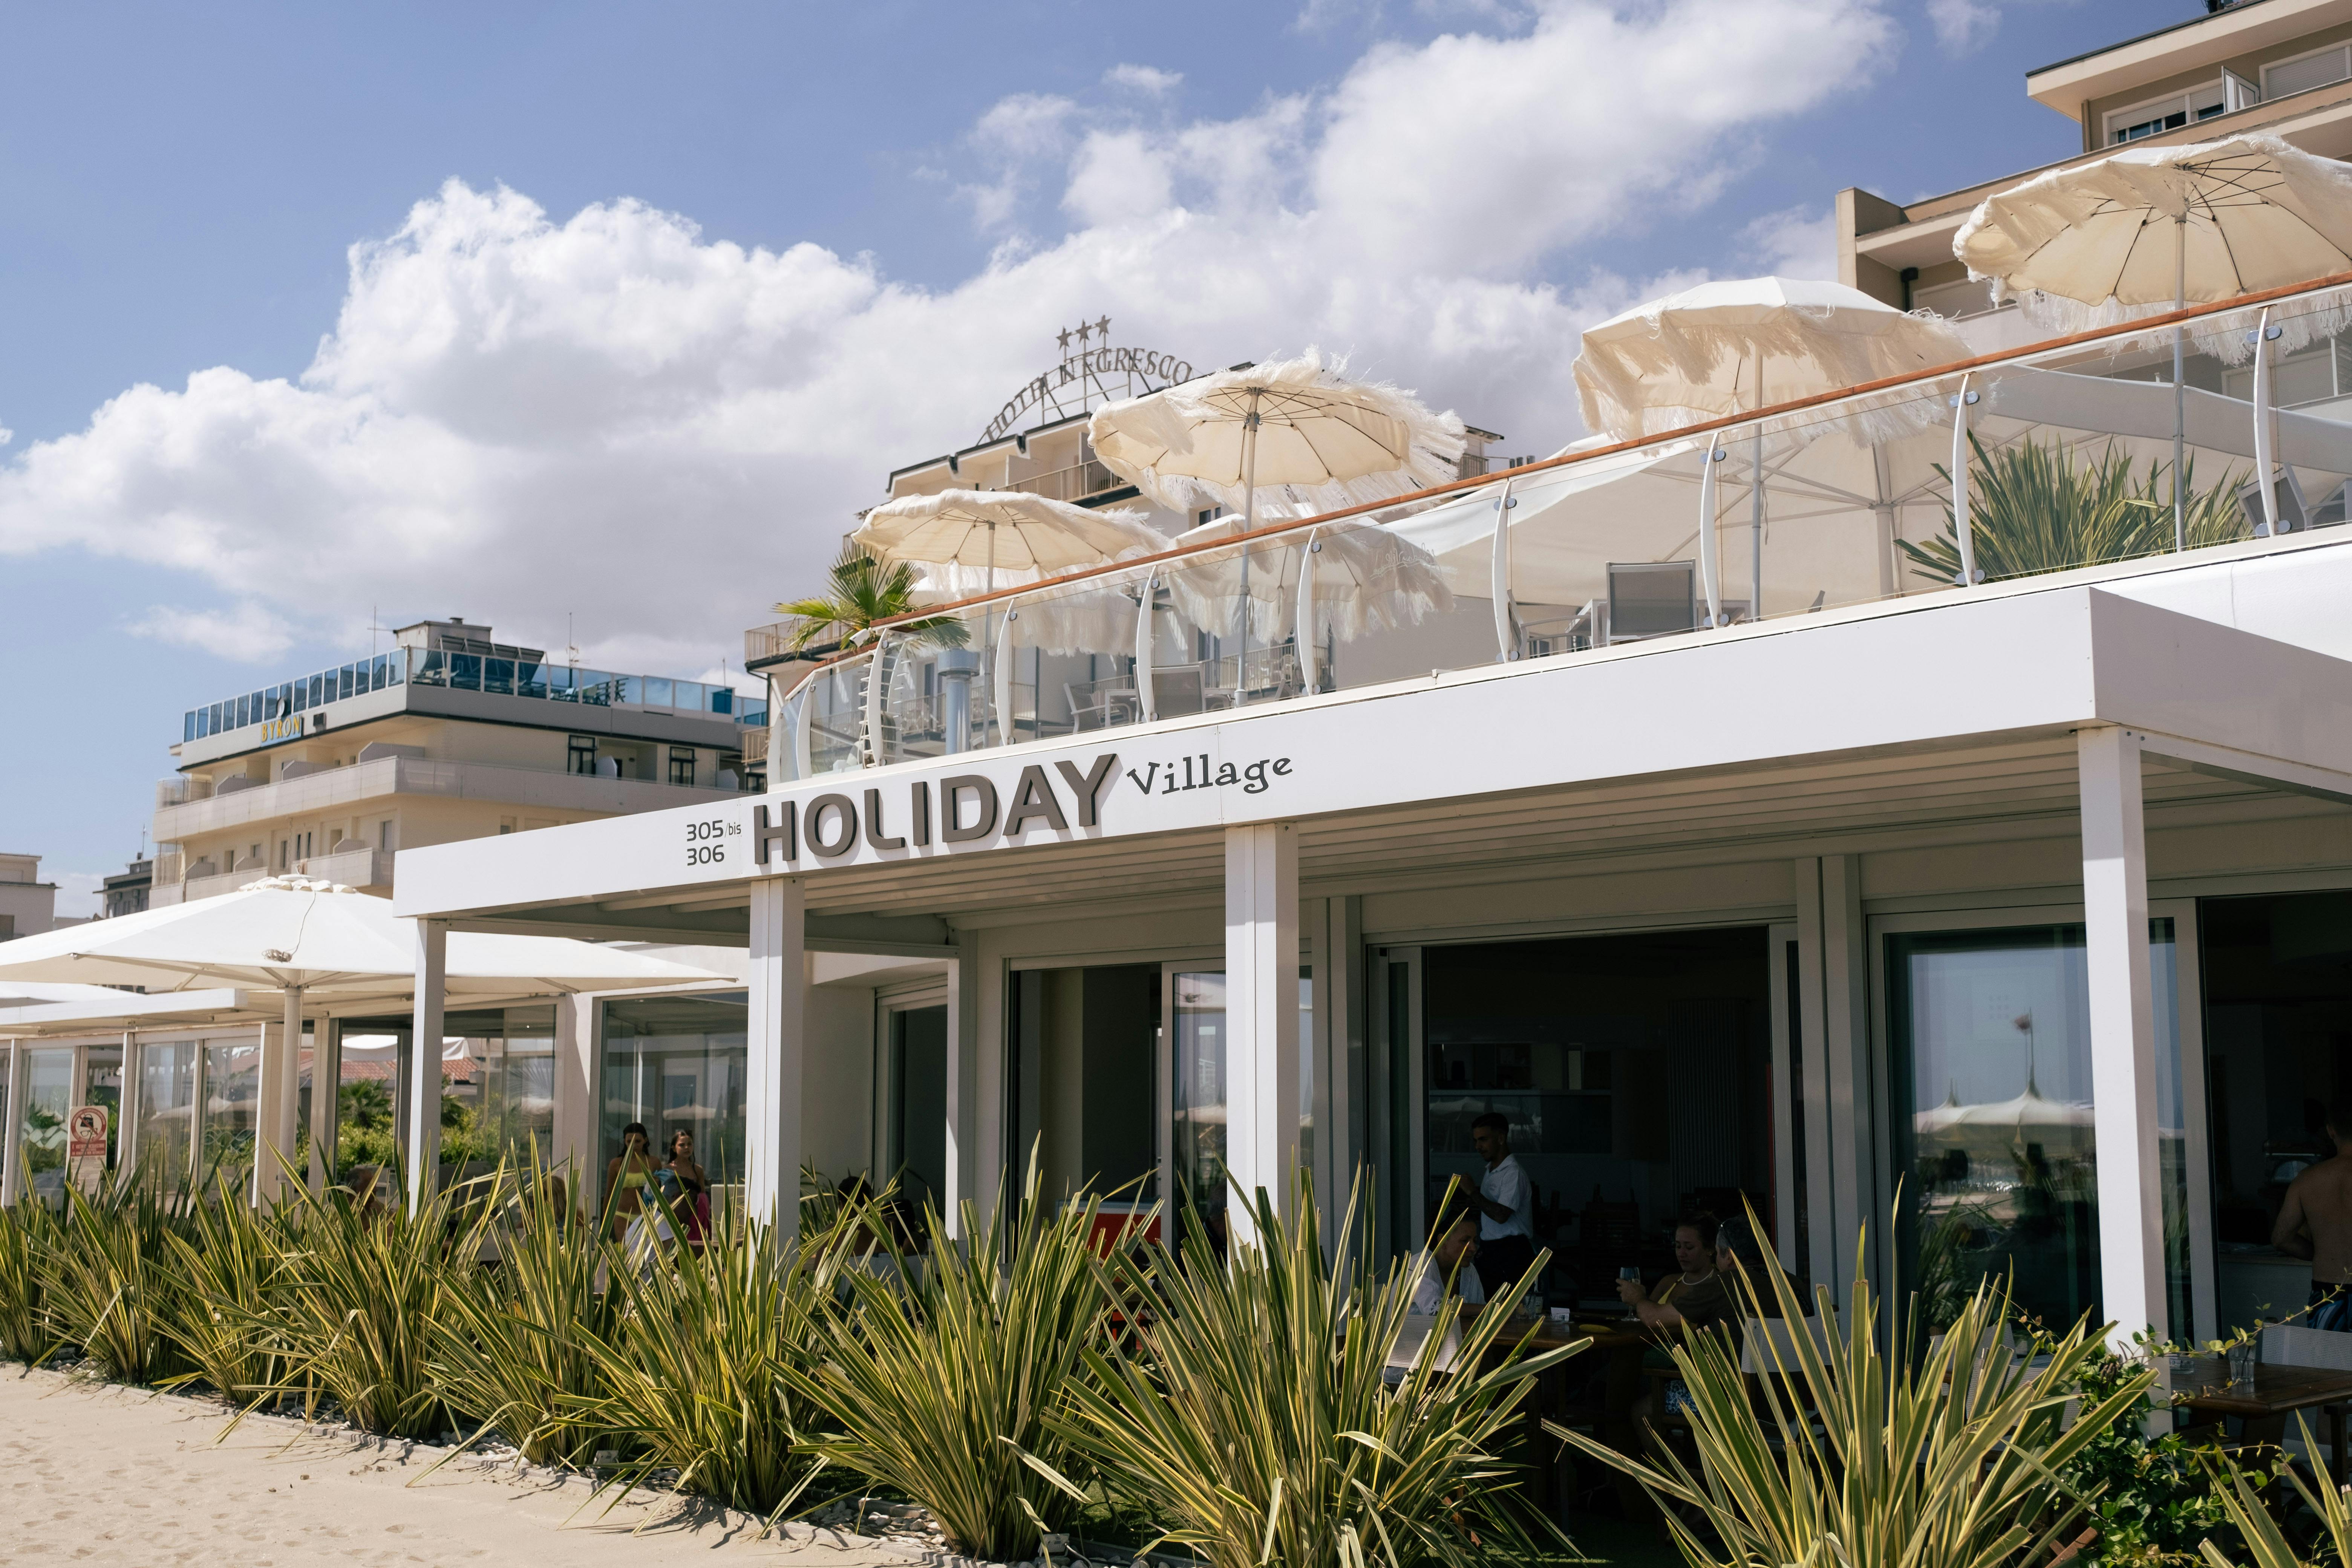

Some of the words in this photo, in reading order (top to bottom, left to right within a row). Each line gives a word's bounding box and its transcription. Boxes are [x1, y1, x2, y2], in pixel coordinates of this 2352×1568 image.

[986, 371, 1056, 441] HOTEL
[1060, 348, 1192, 387] NEGRESCO
[262, 714, 300, 742] BYRON
[754, 753, 1117, 864] HOLIDAY
[1127, 753, 1292, 794] Village
[687, 844, 724, 866] 306
